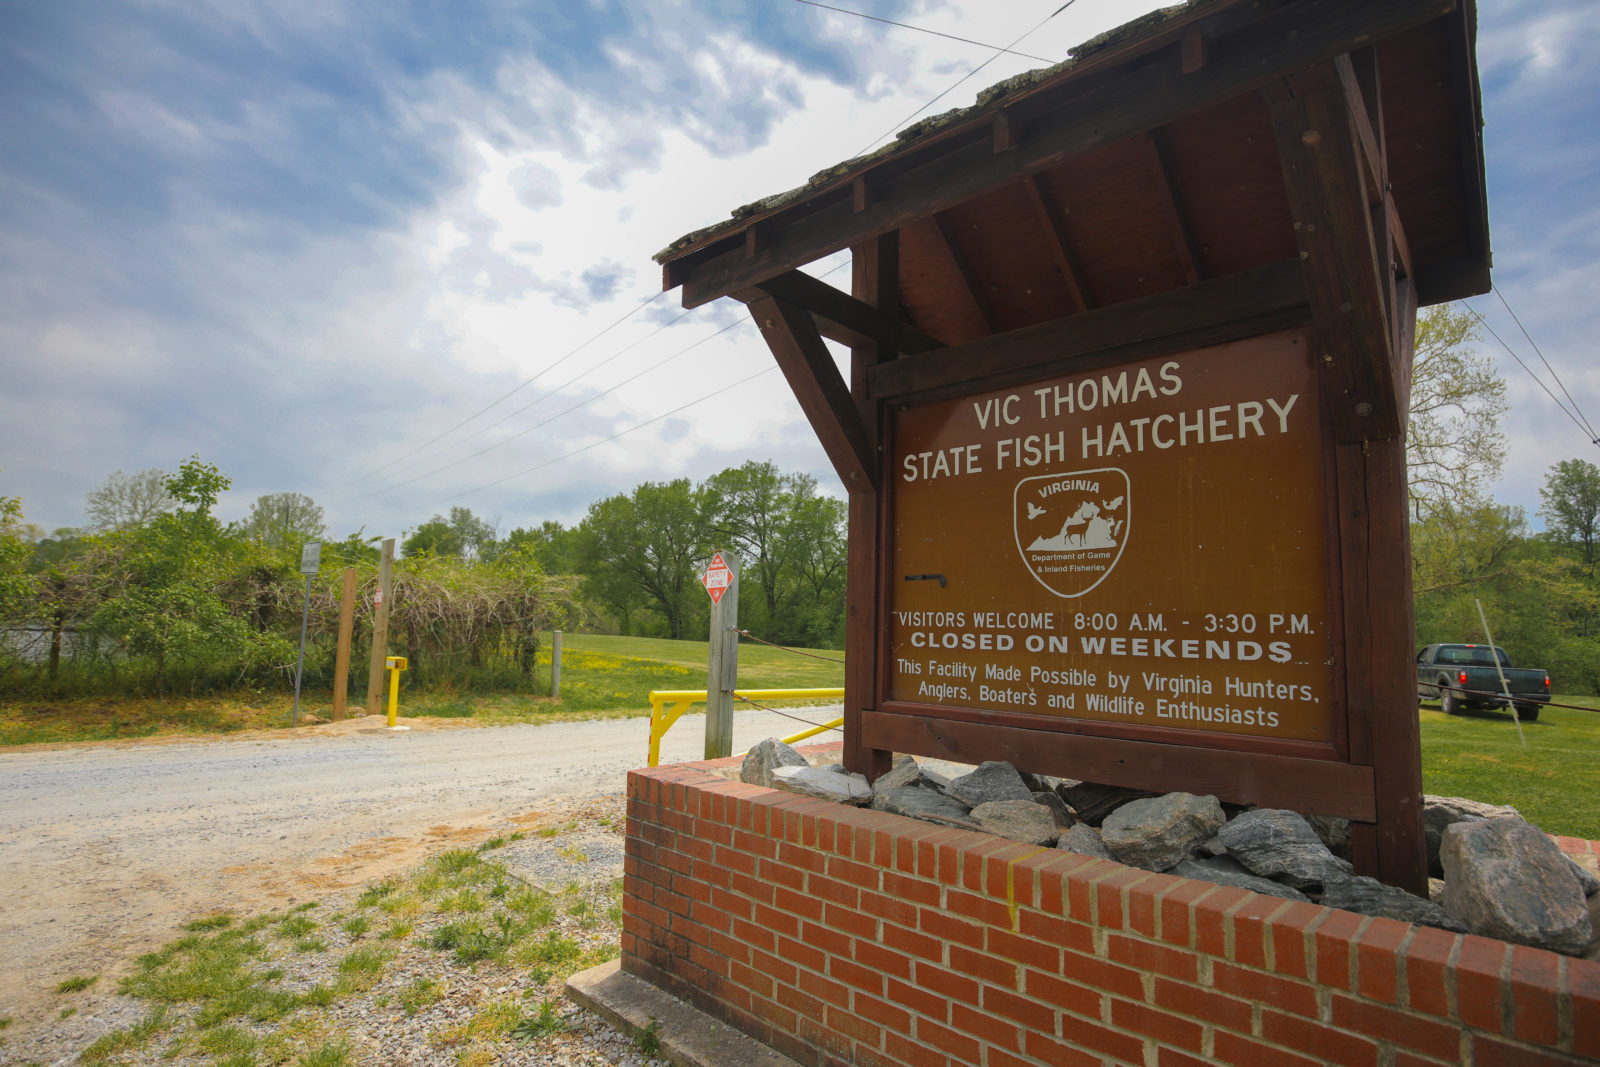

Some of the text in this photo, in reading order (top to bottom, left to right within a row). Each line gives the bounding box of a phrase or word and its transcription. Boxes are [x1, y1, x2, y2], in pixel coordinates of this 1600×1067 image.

[973, 361, 1183, 430] VIC THOMAS
[903, 394, 1299, 482] STATE FISH HATCHERY
[1038, 479, 1100, 498] VIRGINIA
[1032, 553, 1075, 563] Department
[1077, 552, 1086, 560] of
[1045, 565, 1068, 573] Inland
[1069, 564, 1106, 572] Fisheries
[899, 611, 966, 628] VISITORS
[973, 612, 1055, 630] WELCOME
[1074, 612, 1118, 631] 8:00
[1128, 613, 1168, 632] A.M.
[1204, 613, 1257, 634] 3:30
[1269, 613, 1315, 635] P.M.
[910, 631, 1293, 664] CLOSED ON WEEKENDS
[897, 658, 1319, 704] This Facility Made Possible by Virginia Hunters,
[918, 680, 1279, 727] Anglers, Boaters and Wildlife Enthusiasts
